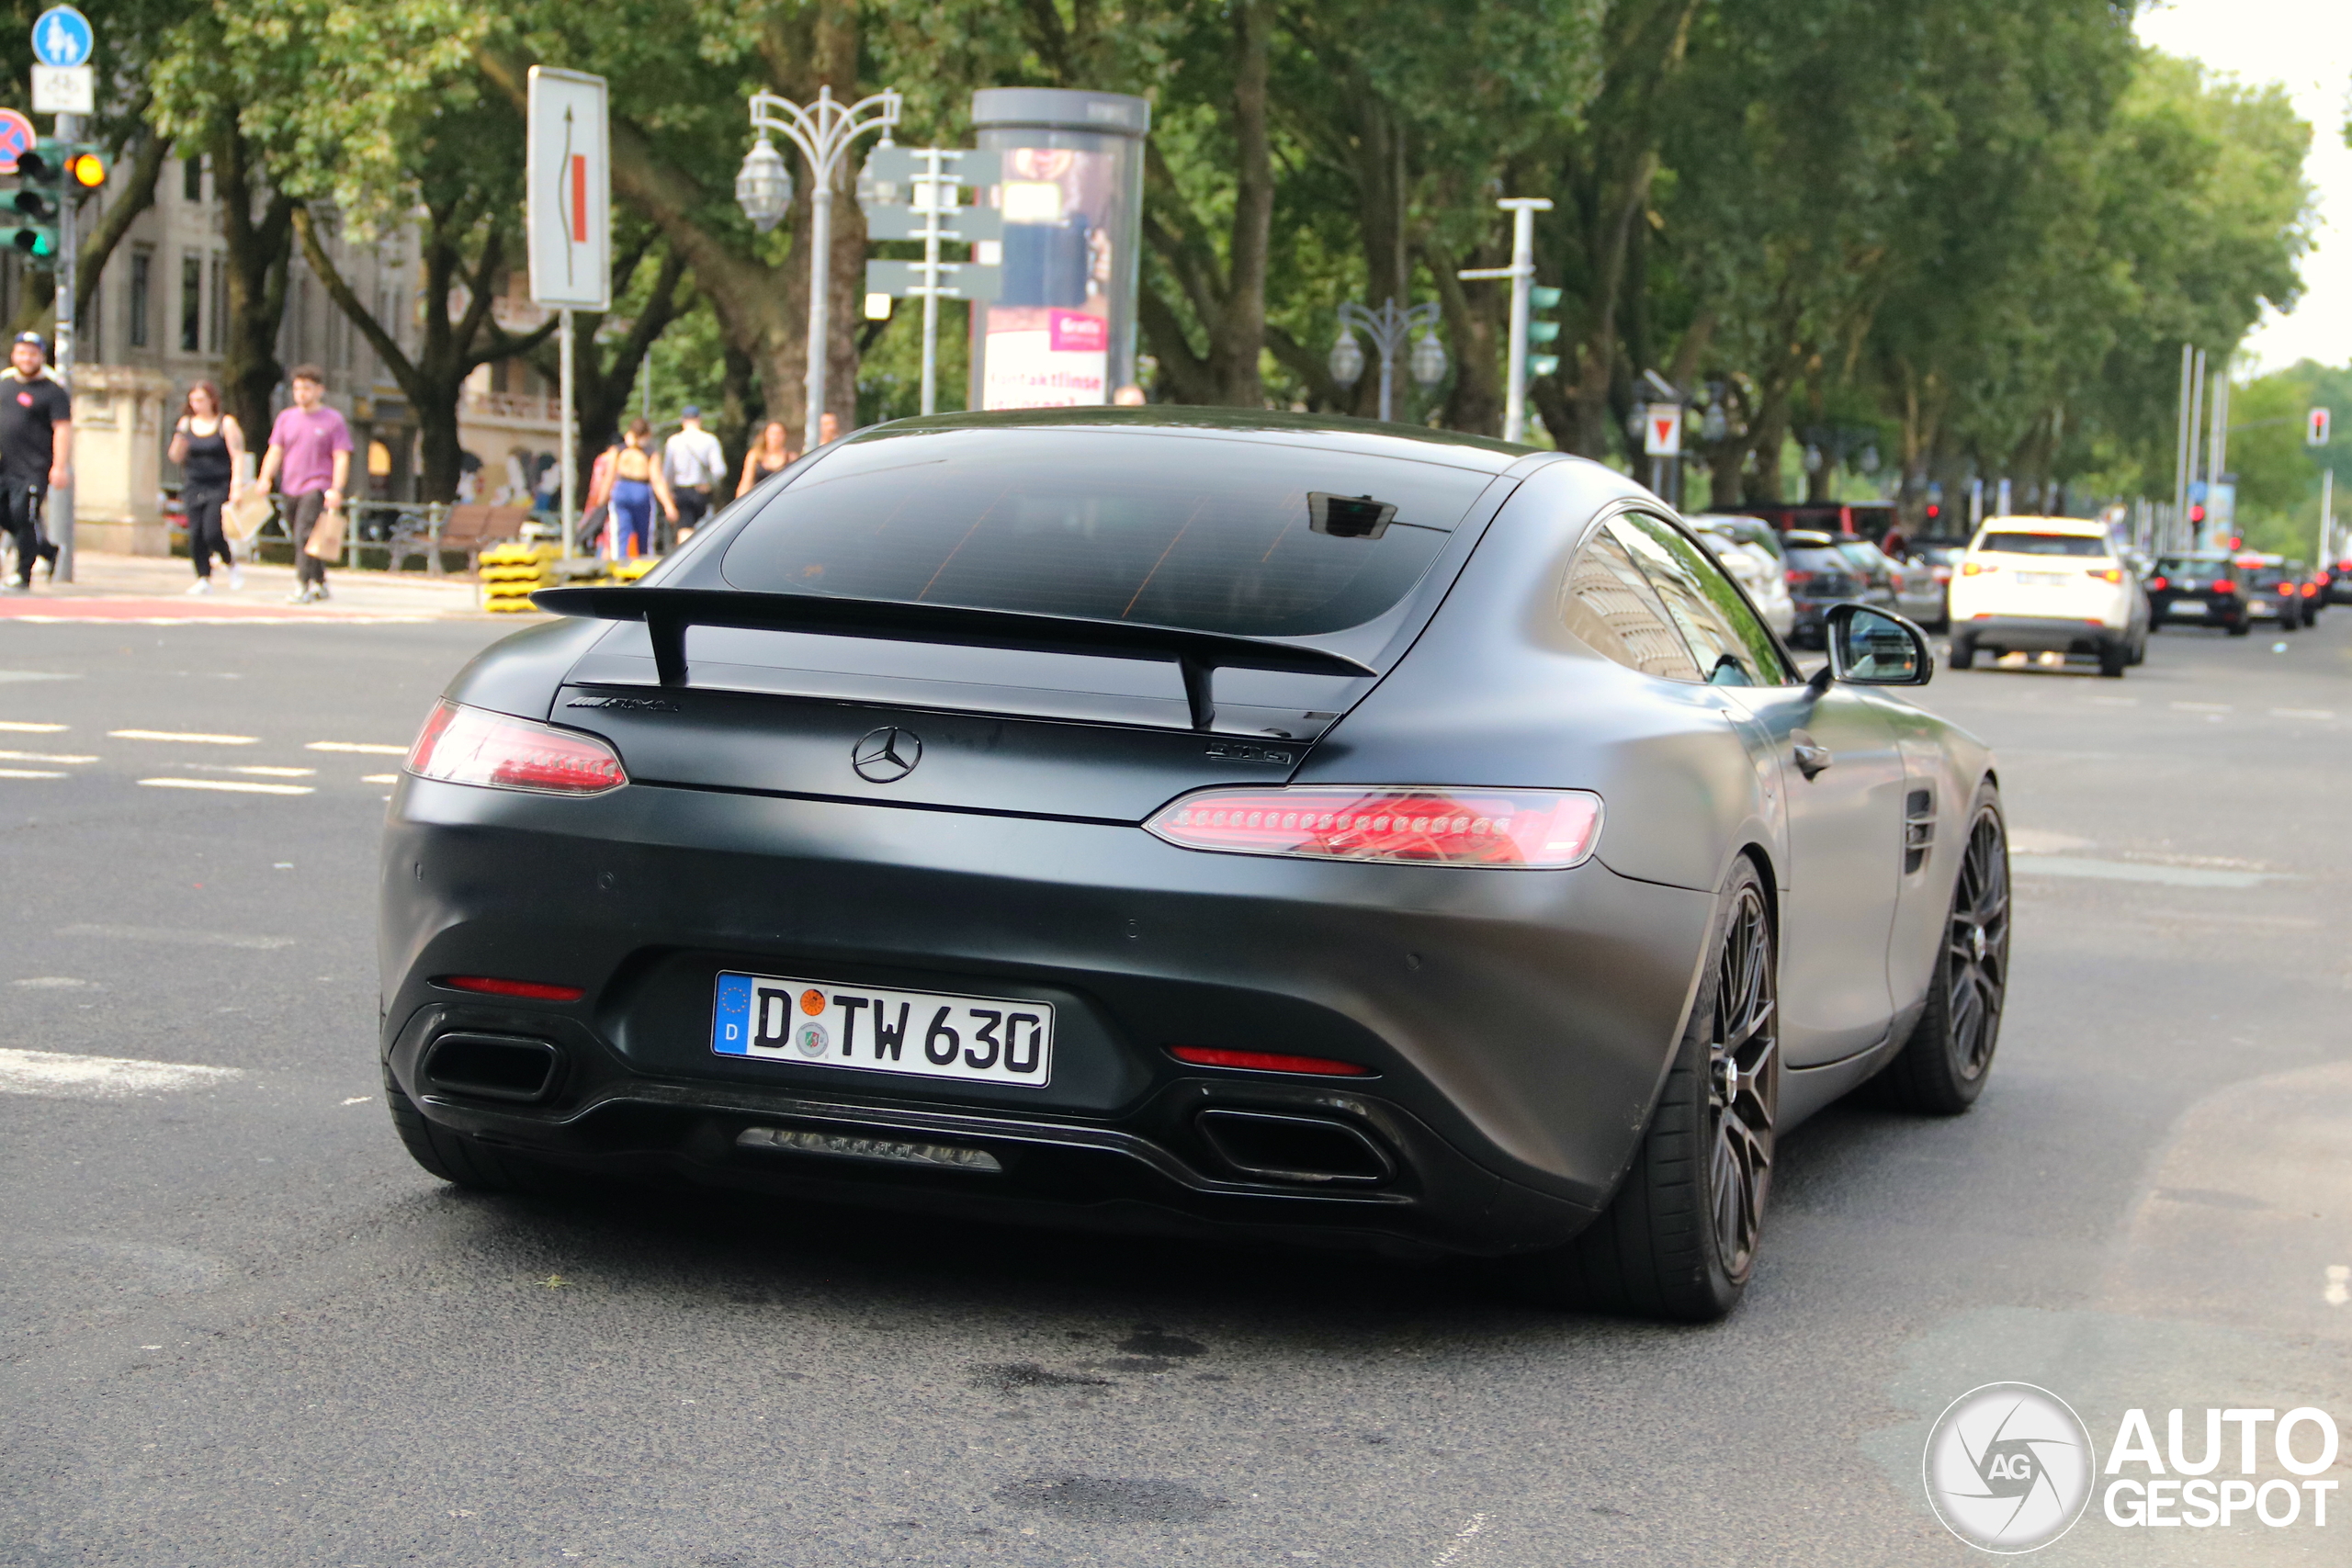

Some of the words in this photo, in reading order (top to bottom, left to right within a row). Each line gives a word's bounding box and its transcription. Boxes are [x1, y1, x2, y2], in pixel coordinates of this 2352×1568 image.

[725, 1024, 738, 1040] D
[754, 987, 792, 1048] D
[832, 995, 910, 1061] TW
[924, 1006, 1040, 1073] 630
